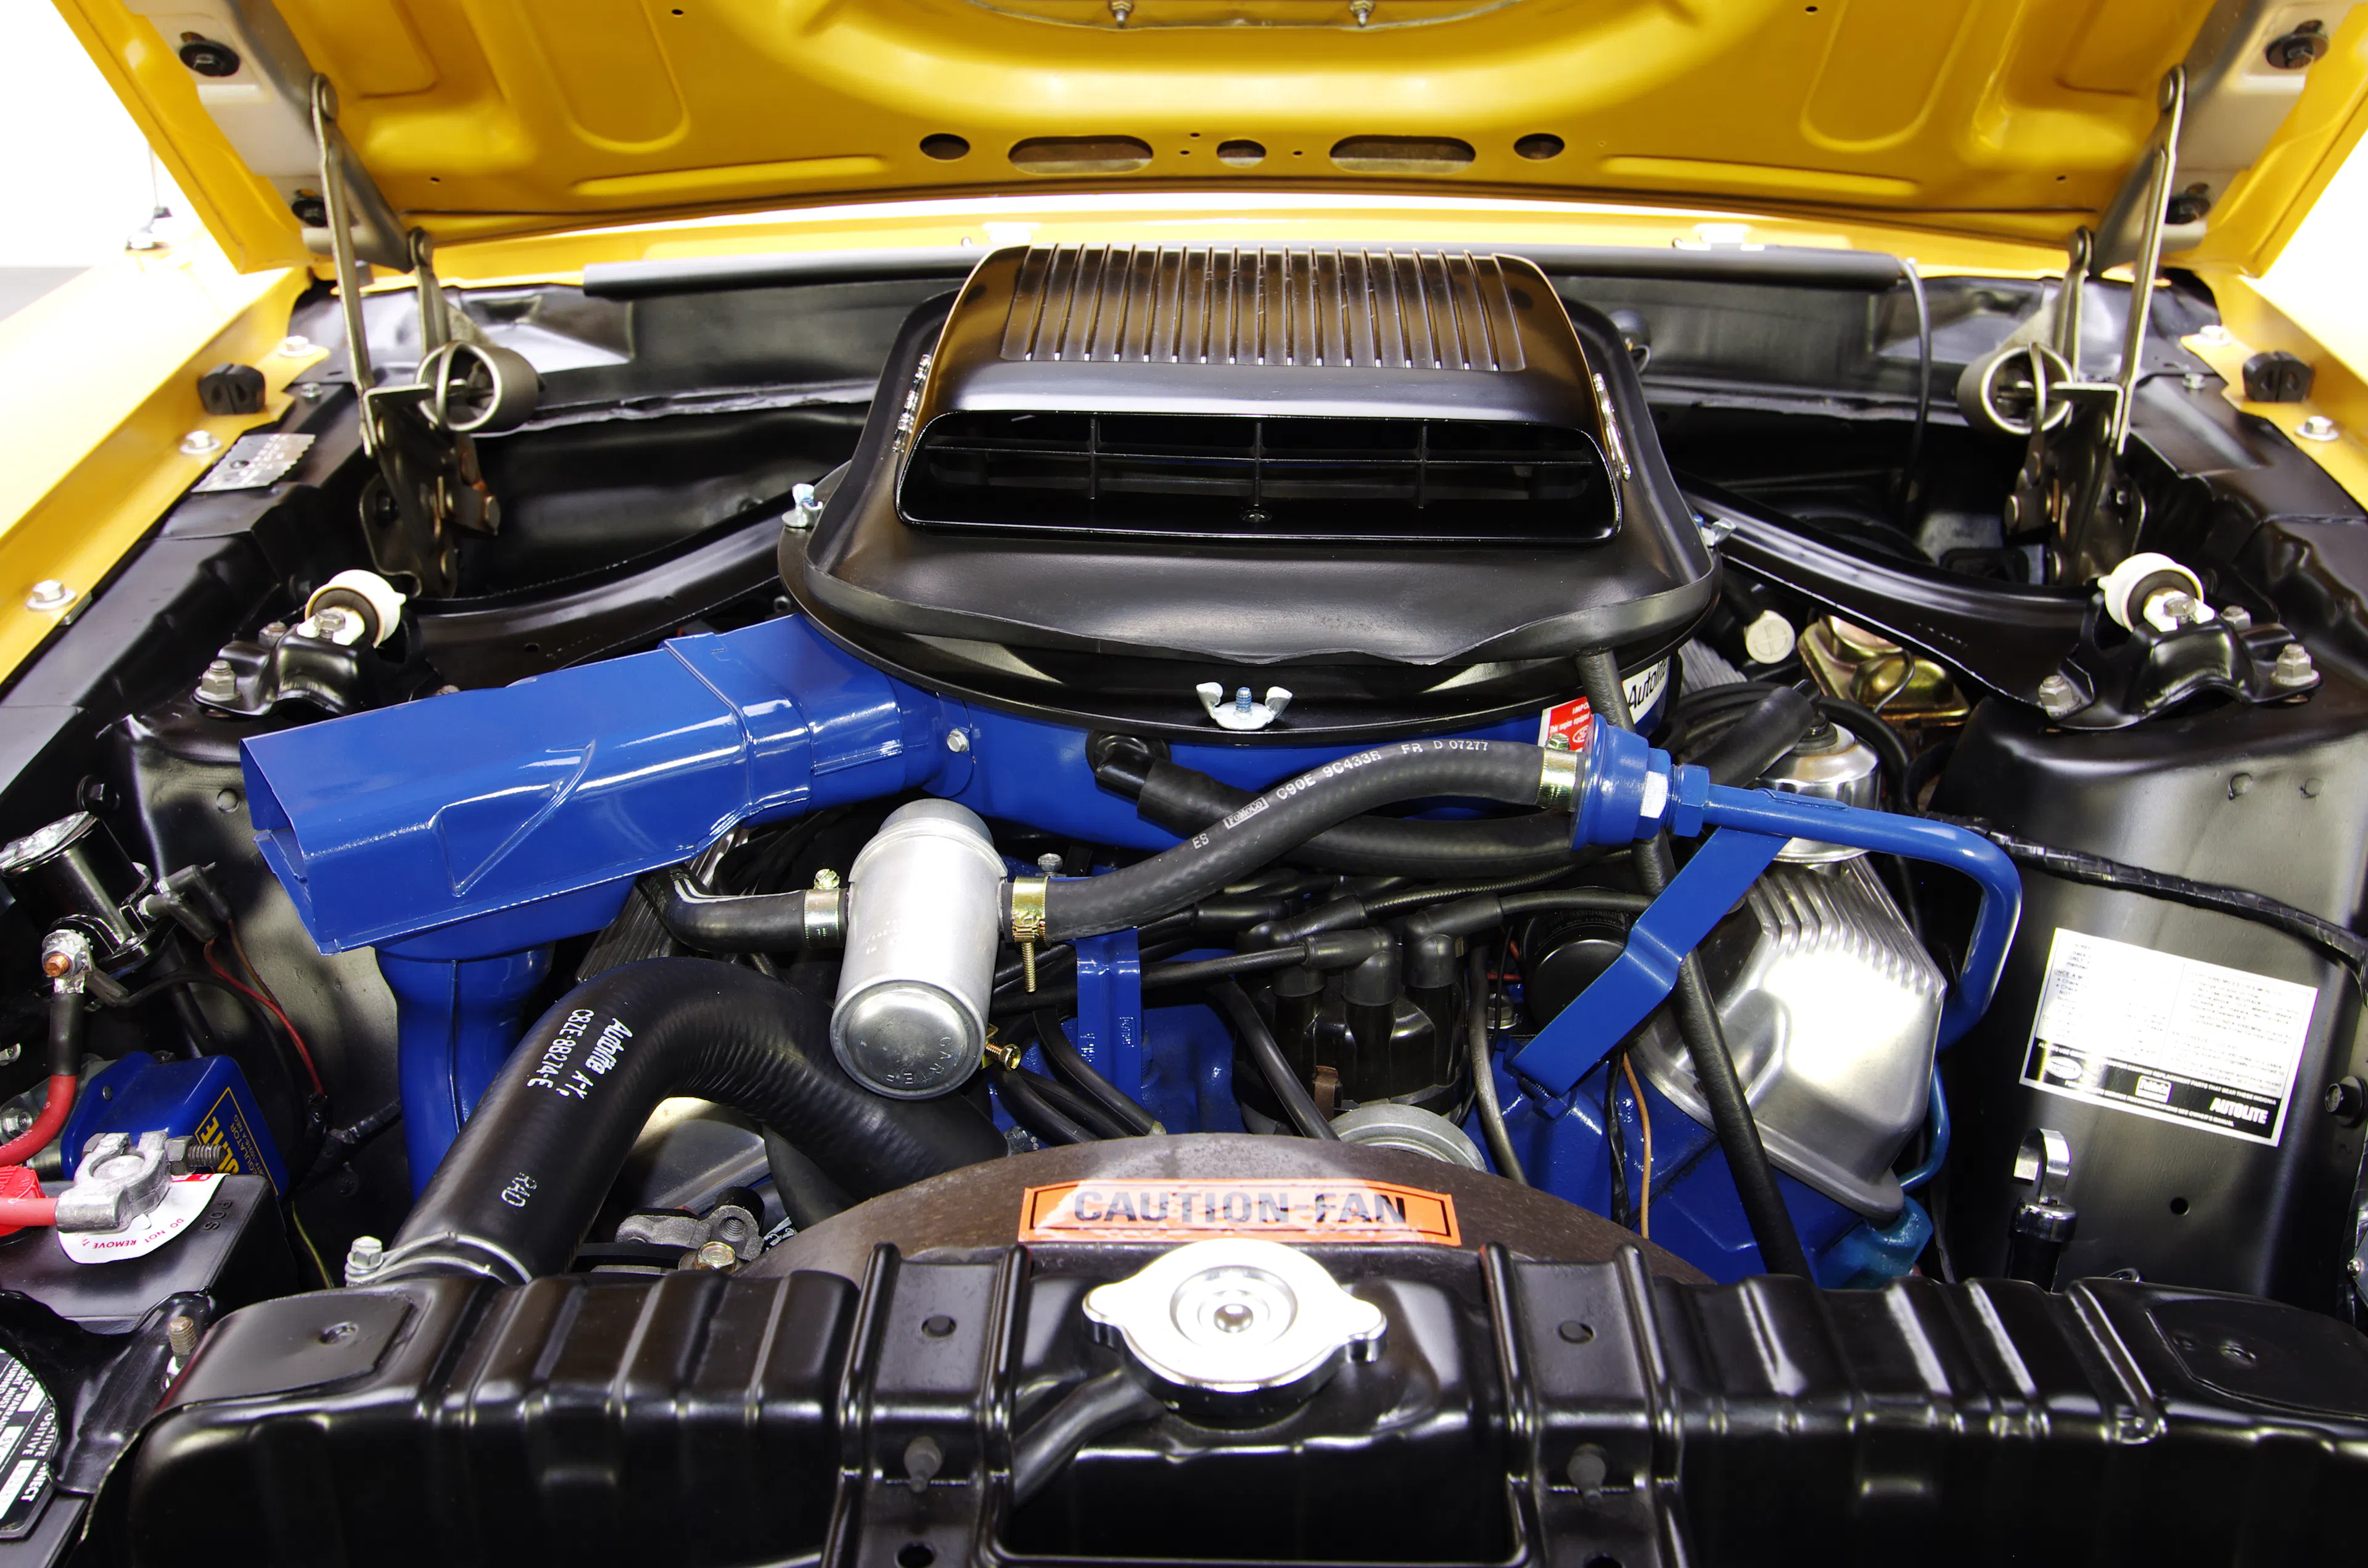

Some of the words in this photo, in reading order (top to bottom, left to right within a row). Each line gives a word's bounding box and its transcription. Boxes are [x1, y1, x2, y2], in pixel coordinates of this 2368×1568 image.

[1226, 799, 1265, 827] FoMoCo
[1433, 740, 1444, 750] D
[1449, 740, 1489, 751] 07277
[527, 1009, 594, 1089] C8ZE-8B274-E
[585, 1017, 633, 1075] Autolite
[2209, 1097, 2268, 1125] AUTOLITE
[170, 1218, 185, 1229] DO
[202, 1201, 234, 1231] POS
[92, 1239, 138, 1250] REMOVE
[144, 1229, 166, 1244] NOT
[22, 1410, 56, 1456] OSITIVE
